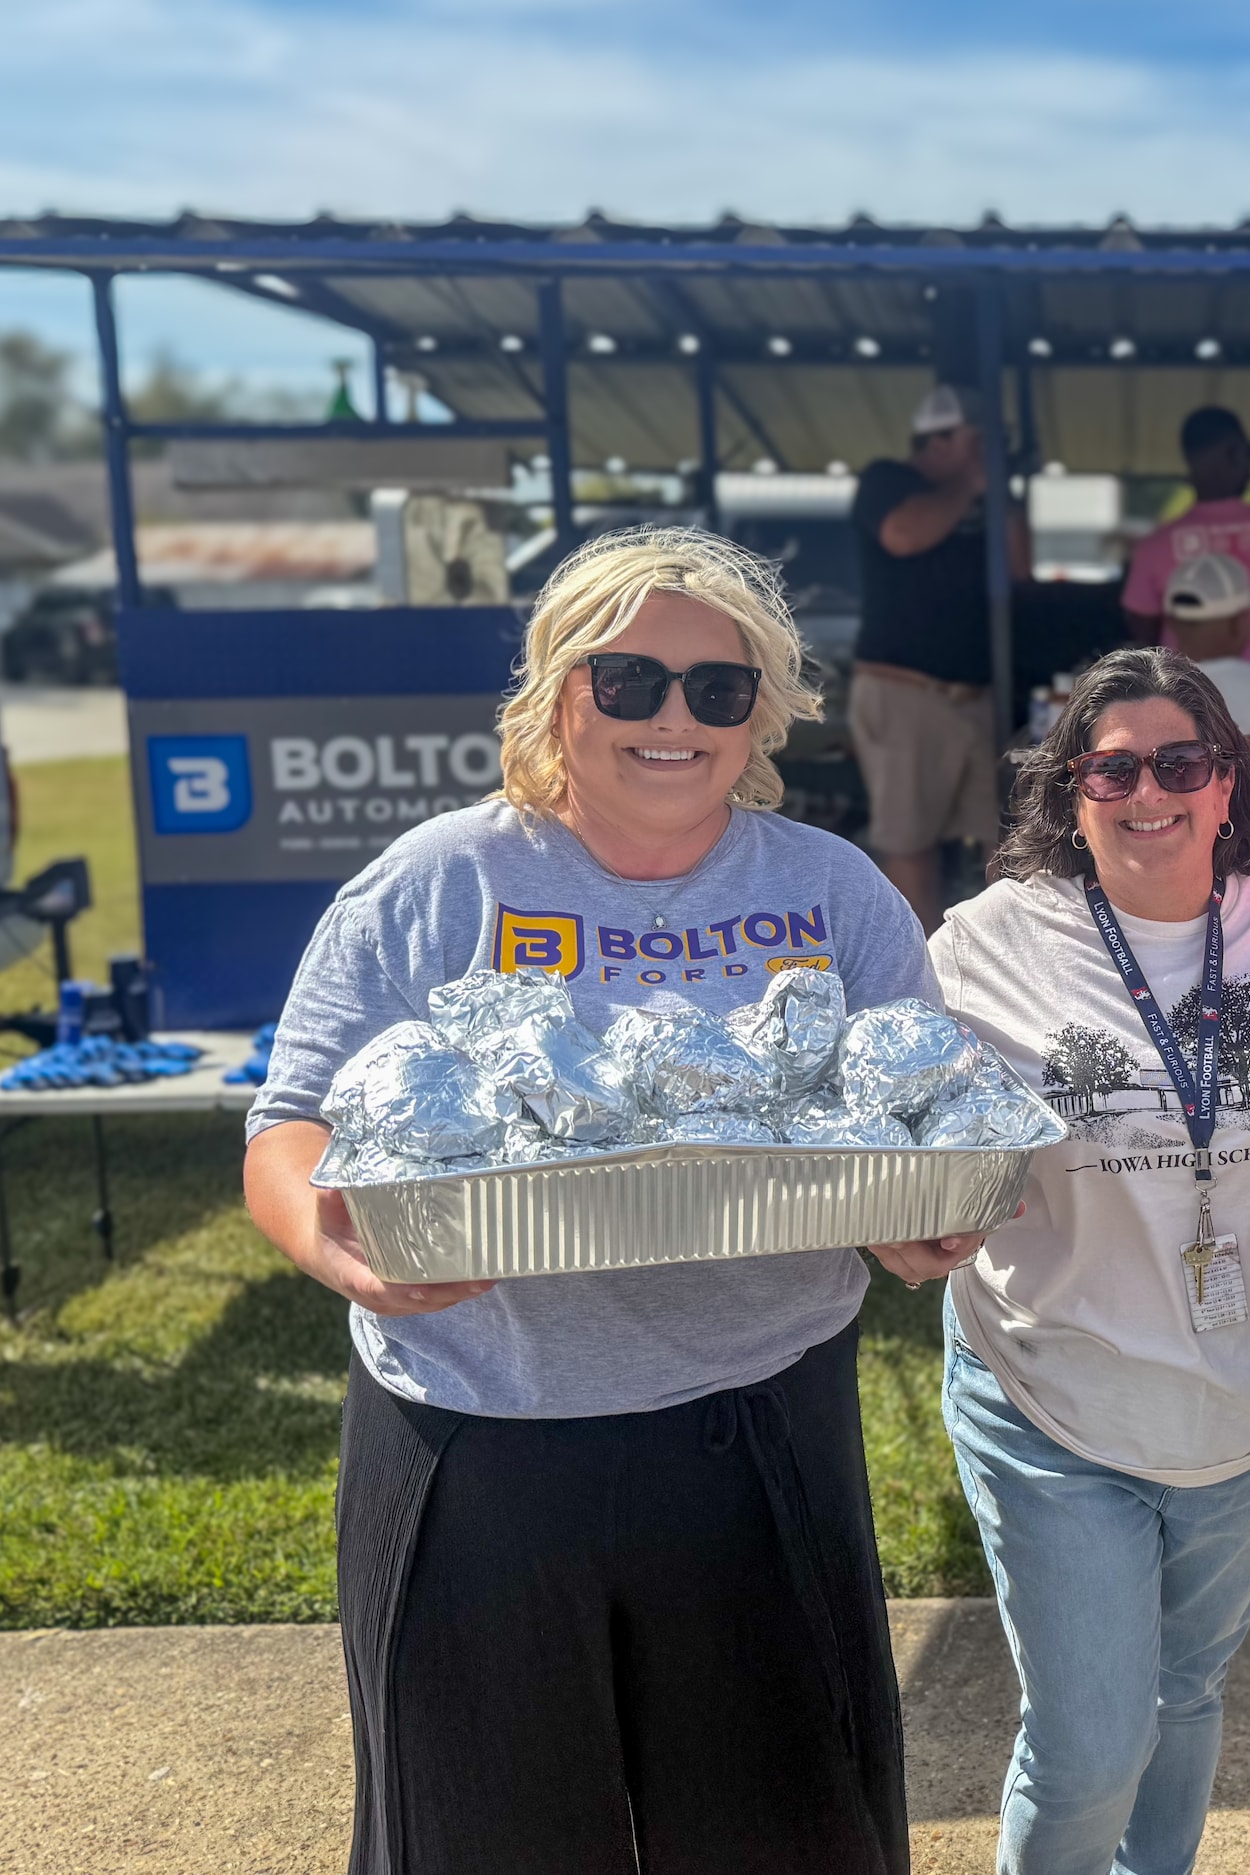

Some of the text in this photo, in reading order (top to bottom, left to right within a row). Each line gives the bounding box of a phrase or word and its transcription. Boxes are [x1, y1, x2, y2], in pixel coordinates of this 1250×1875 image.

[270, 733, 503, 791] BOLTO
[597, 904, 828, 962] BOLTON
[1094, 901, 1134, 976] LYON FOOTBALL
[1209, 916, 1219, 957] FURIOUS
[600, 963, 748, 986] FORD
[1207, 968, 1217, 992] FAST
[1147, 1013, 1165, 1037] FAST
[1163, 1046, 1188, 1089] FURIOUS
[1199, 1035, 1214, 1119] LYON FOOTBALL
[1099, 1155, 1152, 1174] IOWA
